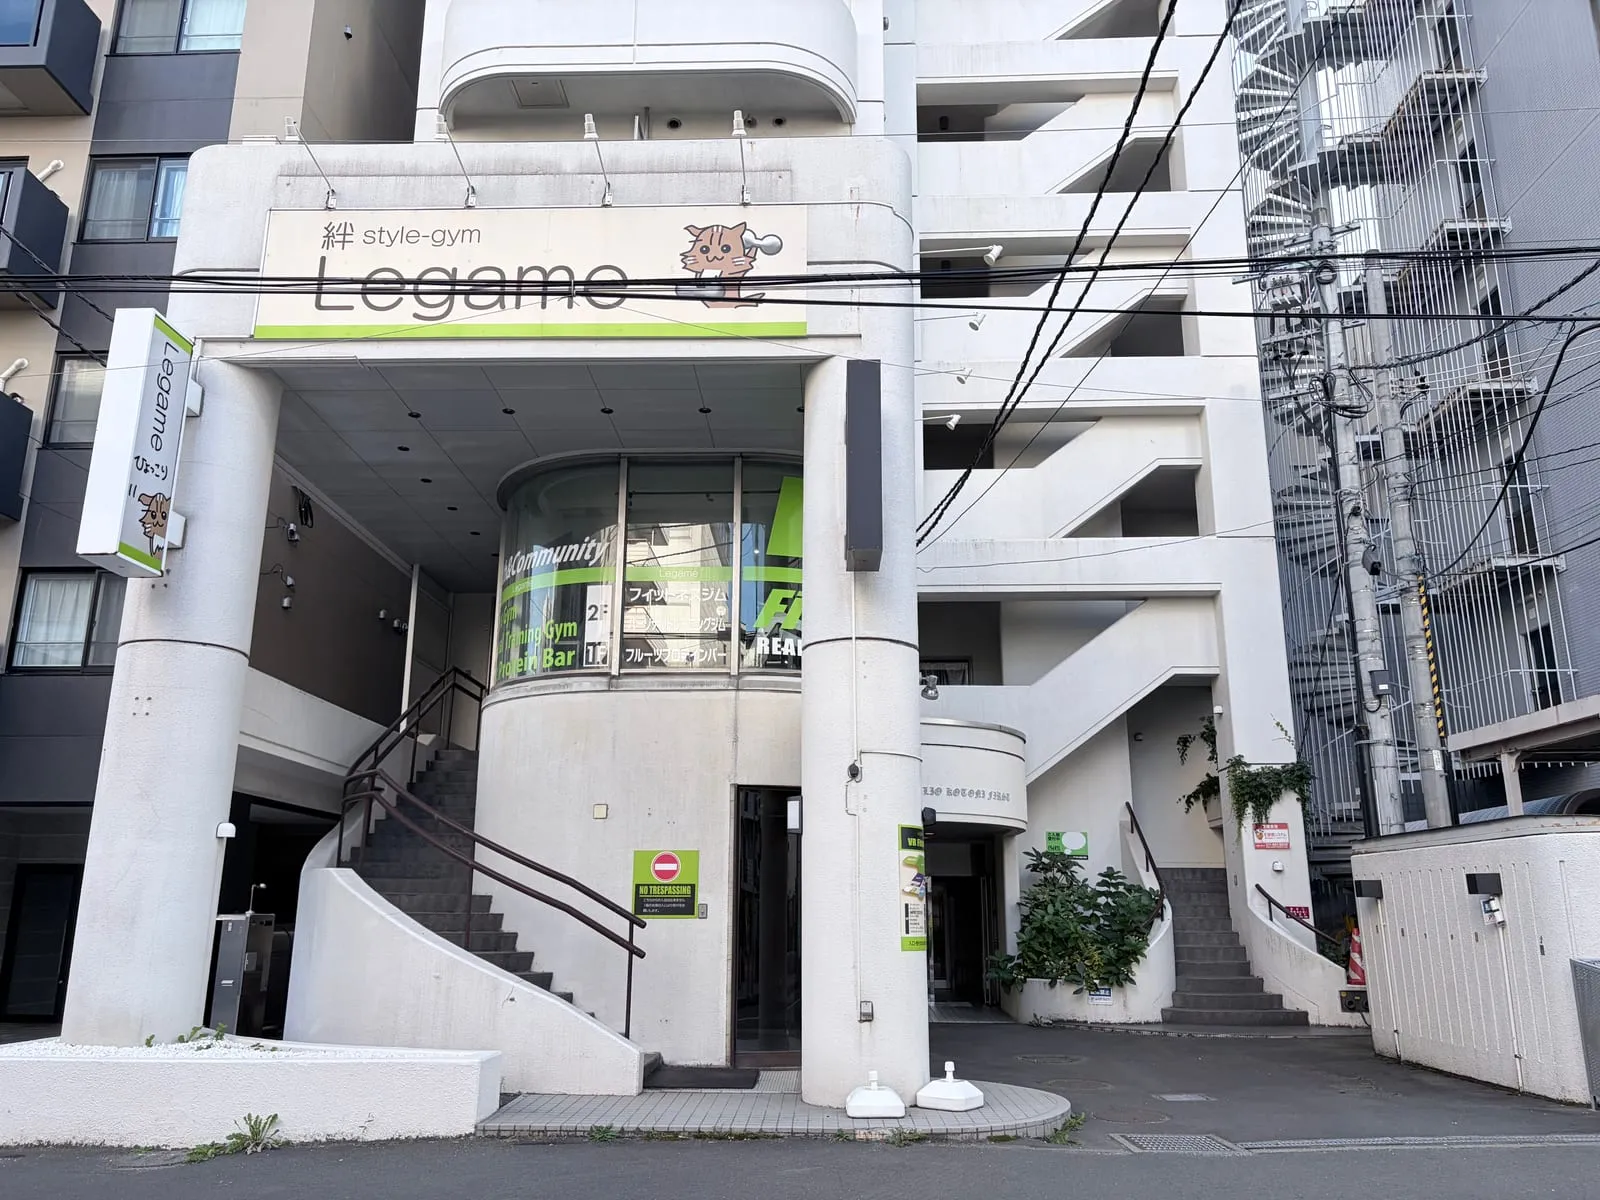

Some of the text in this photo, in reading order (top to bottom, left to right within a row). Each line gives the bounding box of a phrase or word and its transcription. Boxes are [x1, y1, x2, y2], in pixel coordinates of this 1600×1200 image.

[321, 221, 482, 251] 絆 style-gym
[314, 255, 629, 322] Legame
[150, 341, 179, 452] Legame
[134, 455, 168, 481] ひょっこり
[660, 568, 698, 579] Legame
[629, 587, 727, 602] フィットネジム
[544, 619, 578, 644] Gym
[542, 647, 576, 668] Bar
[639, 885, 692, 895] NO TRESPASSING
